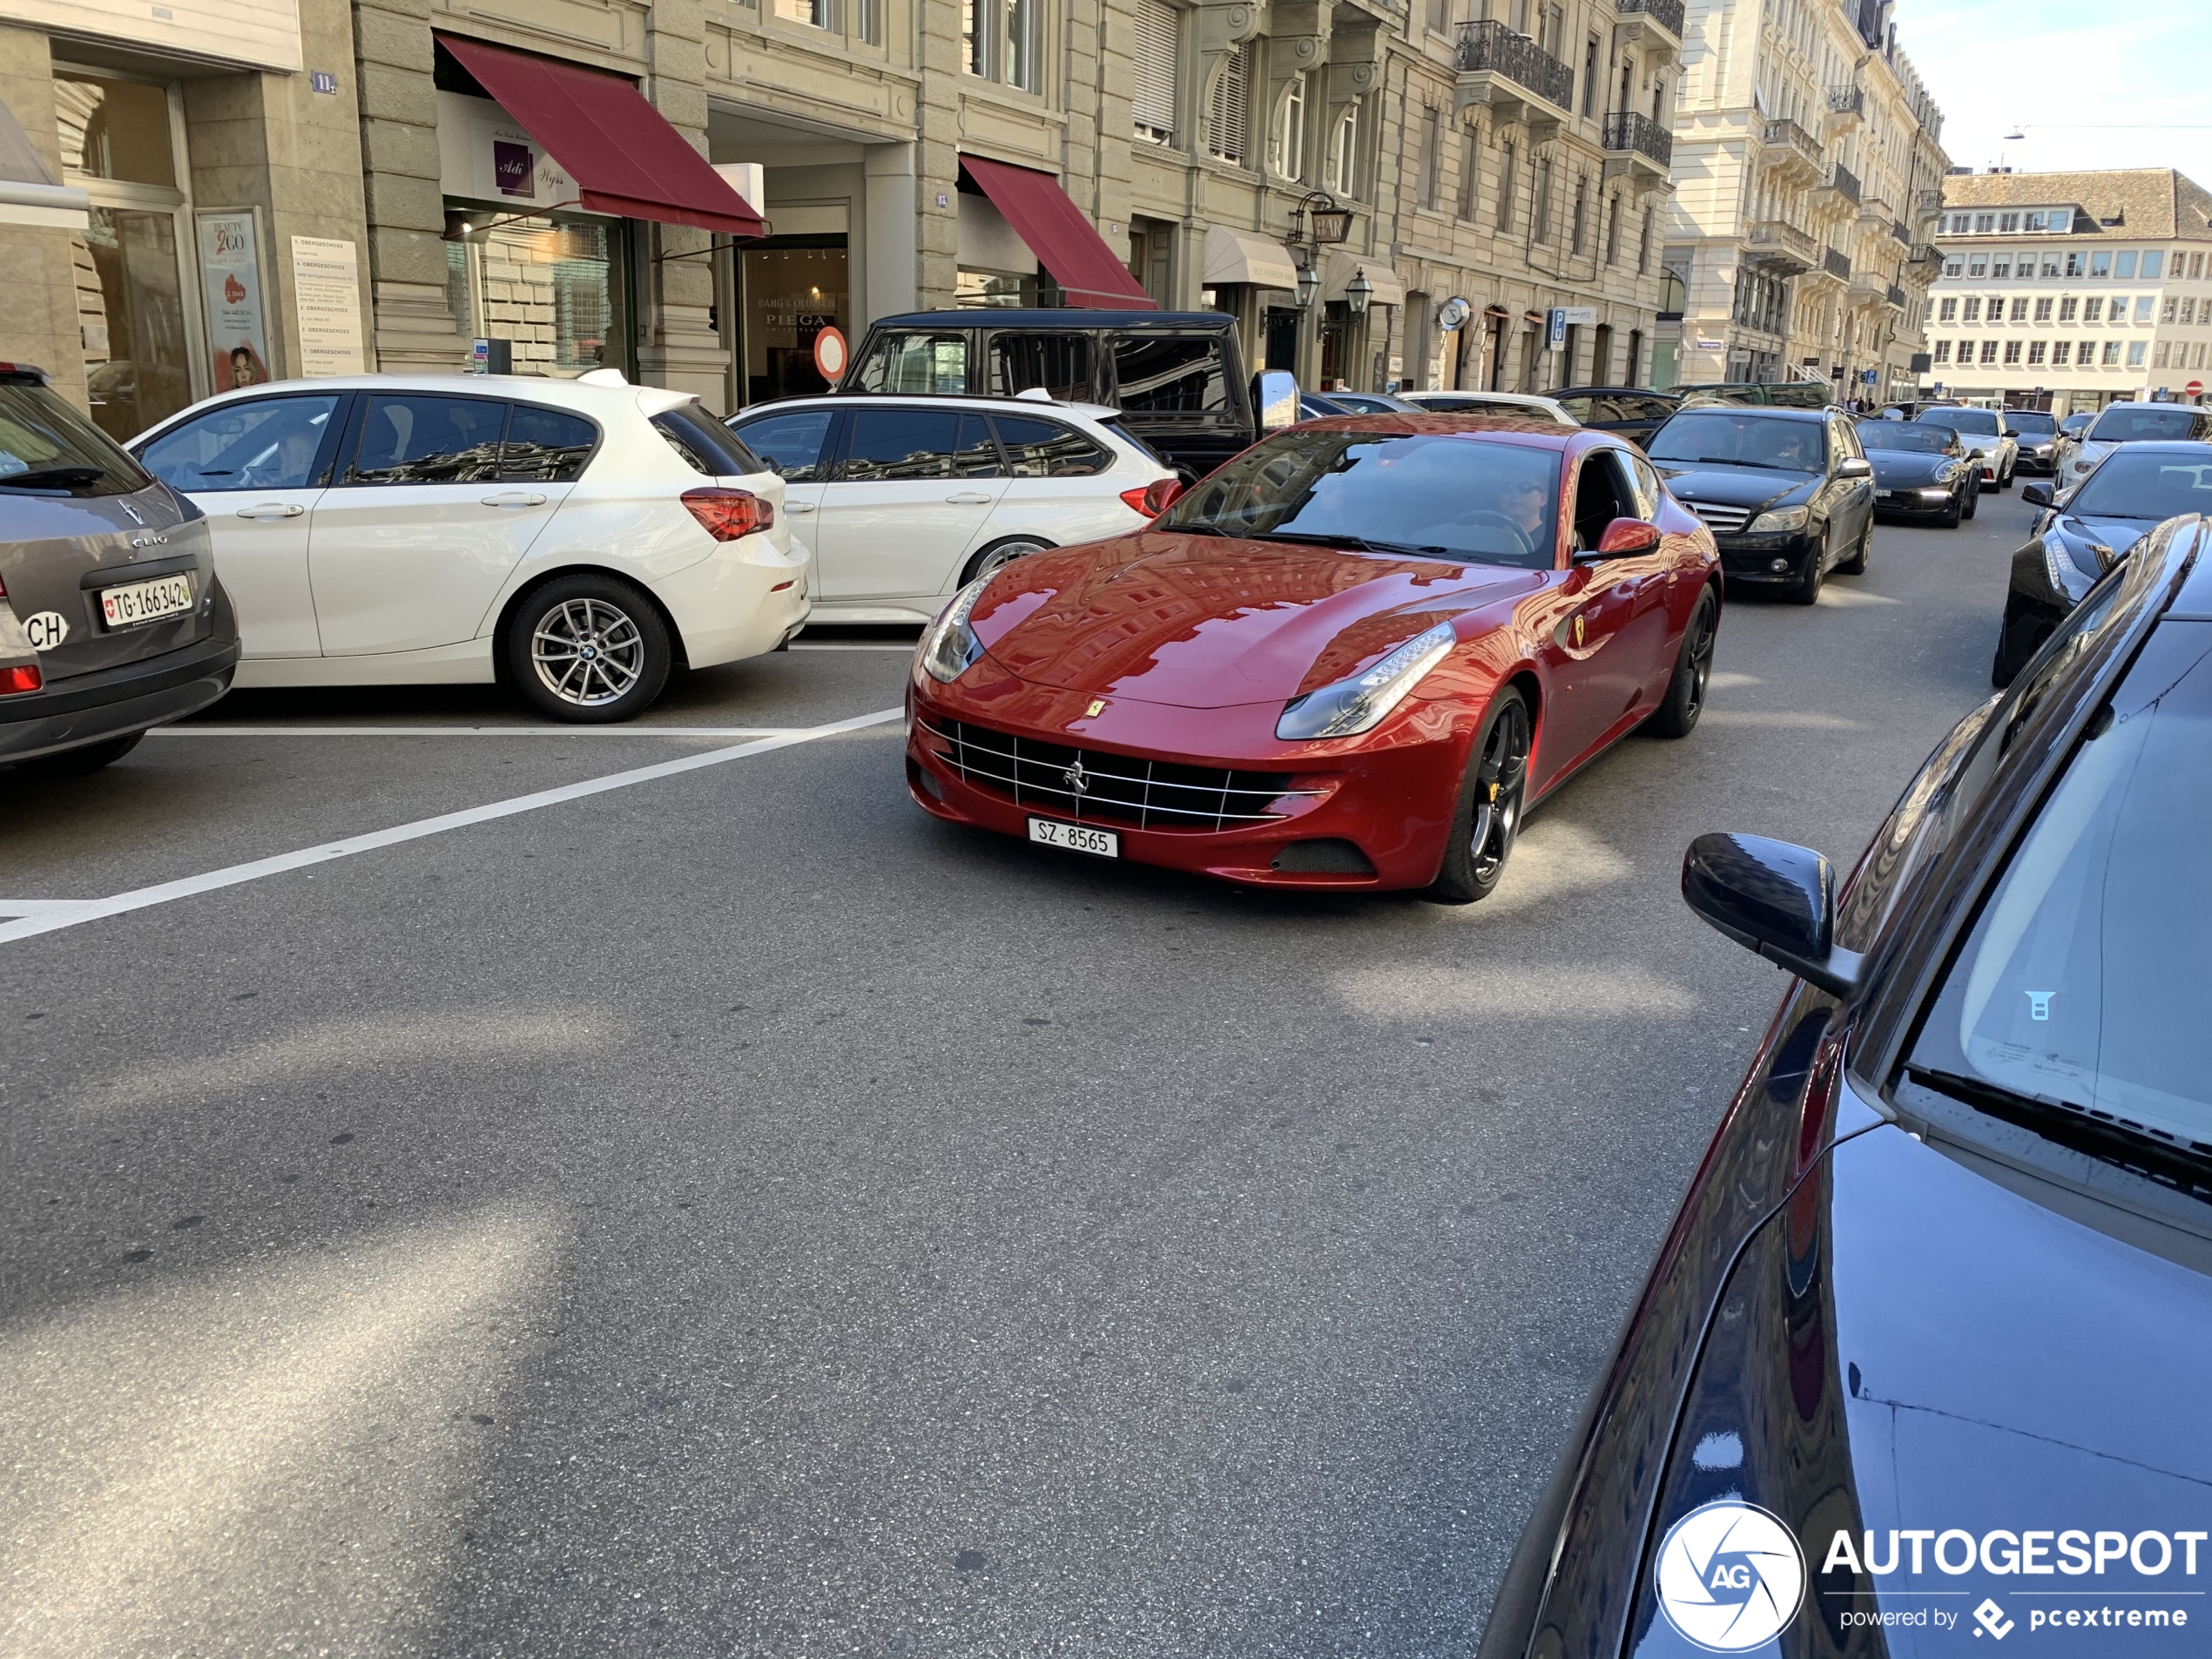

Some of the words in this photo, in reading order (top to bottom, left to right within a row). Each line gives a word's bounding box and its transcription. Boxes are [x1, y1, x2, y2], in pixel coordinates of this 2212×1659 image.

[318, 74, 330, 91] 11
[500, 160, 523, 175] Adi
[539, 168, 563, 189] Wyss
[214, 223, 241, 233] BEAUTY
[1317, 218, 1342, 237] BAR
[301, 240, 343, 249] OBERGESCHOSS
[759, 299, 783, 308] BANG
[767, 314, 826, 326] PIEGA
[1557, 312, 1563, 327] P
[132, 535, 167, 548] CLIO
[28, 616, 60, 646] CH
